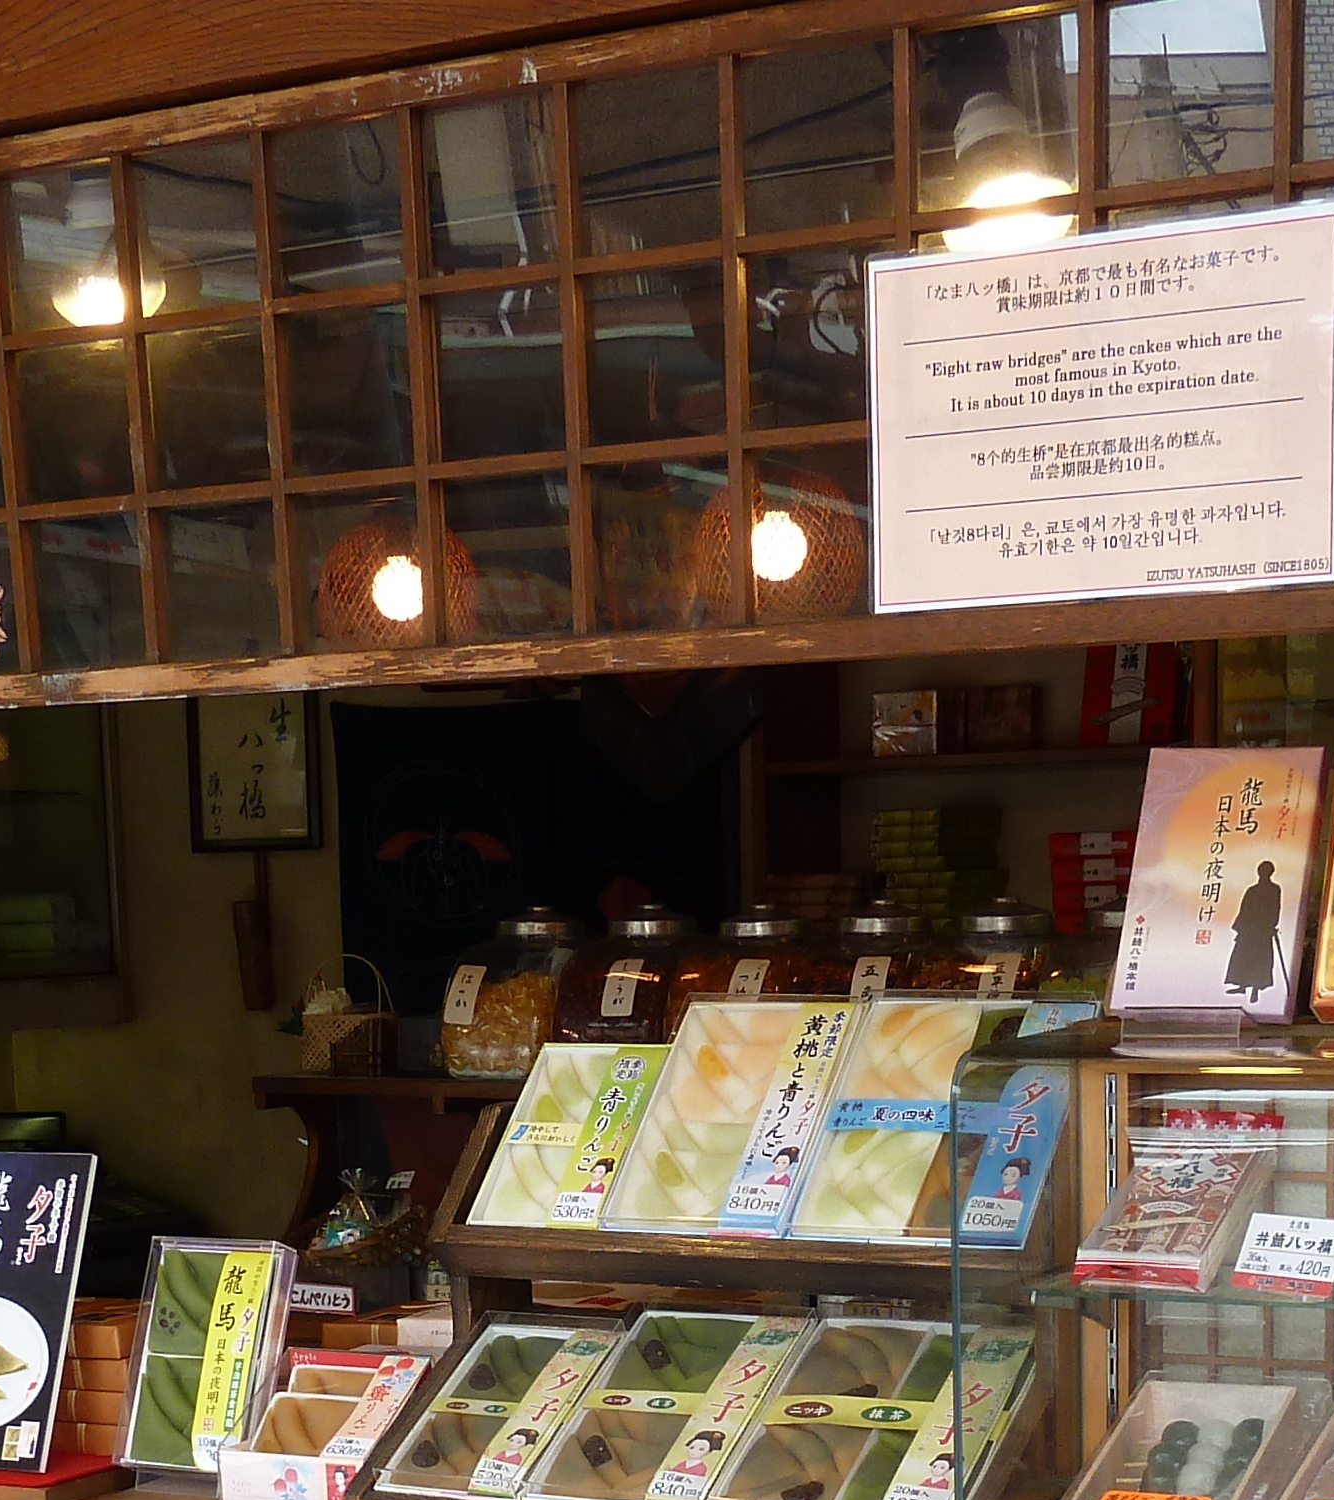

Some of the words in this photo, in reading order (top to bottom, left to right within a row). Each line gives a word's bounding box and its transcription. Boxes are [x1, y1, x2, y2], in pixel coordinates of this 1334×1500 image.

[925, 359, 971, 378] "Eight
[975, 359, 1002, 372] raw
[1008, 348, 1067, 370] bridges"
[1072, 348, 1095, 361] are
[1101, 342, 1124, 358] the
[1129, 338, 1171, 355] cakes
[1177, 332, 1221, 350] which
[1227, 330, 1251, 344] are
[1257, 326, 1282, 342] the
[1014, 370, 1050, 387] most
[1054, 364, 1107, 383] famous
[1112, 361, 1127, 376] in
[1132, 356, 1181, 377] Kyoto.
[950, 397, 964, 413] It
[967, 395, 980, 410] is
[983, 390, 1025, 408] about
[1029, 389, 1047, 405] 10
[1051, 386, 1085, 406] days
[1089, 383, 1104, 399] in
[1108, 379, 1133, 396] the
[1138, 371, 1216, 396] expiration
[1221, 367, 1260, 384] date.
[1020, 521, 1041, 539] 은,
[1045, 515, 1107, 536] 교토에서
[1111, 512, 1143, 532] 가장
[1148, 507, 1197, 528] 유명한
[1201, 499, 1287, 524] 과자입니다.
[998, 537, 1076, 560] 유효기한은
[1081, 533, 1097, 552] 약
[1102, 527, 1204, 551] 10일간입니다.
[1147, 568, 1184, 583] IZUTSU
[1187, 562, 1257, 580] YATSUHASHI
[1235, 777, 1264, 835] 龍馬
[1198, 795, 1233, 923] 日本の夜明け
[819, 1010, 848, 1059] 季節限定
[761, 1013, 829, 1158] 黄桃と青りんご
[576, 1086, 627, 1172] 青りんご
[793, 1099, 817, 1136] 夕子
[869, 1106, 937, 1123] 夏の四味
[998, 1081, 1053, 1155] 夕子
[20, 1184, 54, 1264] 夕子
[552, 1205, 590, 1220] 530円
[728, 1196, 774, 1212] 840円
[1294, 1259, 1332, 1278] 420円
[214, 1265, 248, 1333] 龍馬
[235, 1307, 255, 1353] 夕子
[204, 1338, 226, 1416] 日本の夜明け
[529, 1368, 581, 1423] 夕子
[711, 1359, 768, 1423] 夕子
[788, 1405, 828, 1416] ニッキ
[868, 1407, 906, 1421] 抹茶
